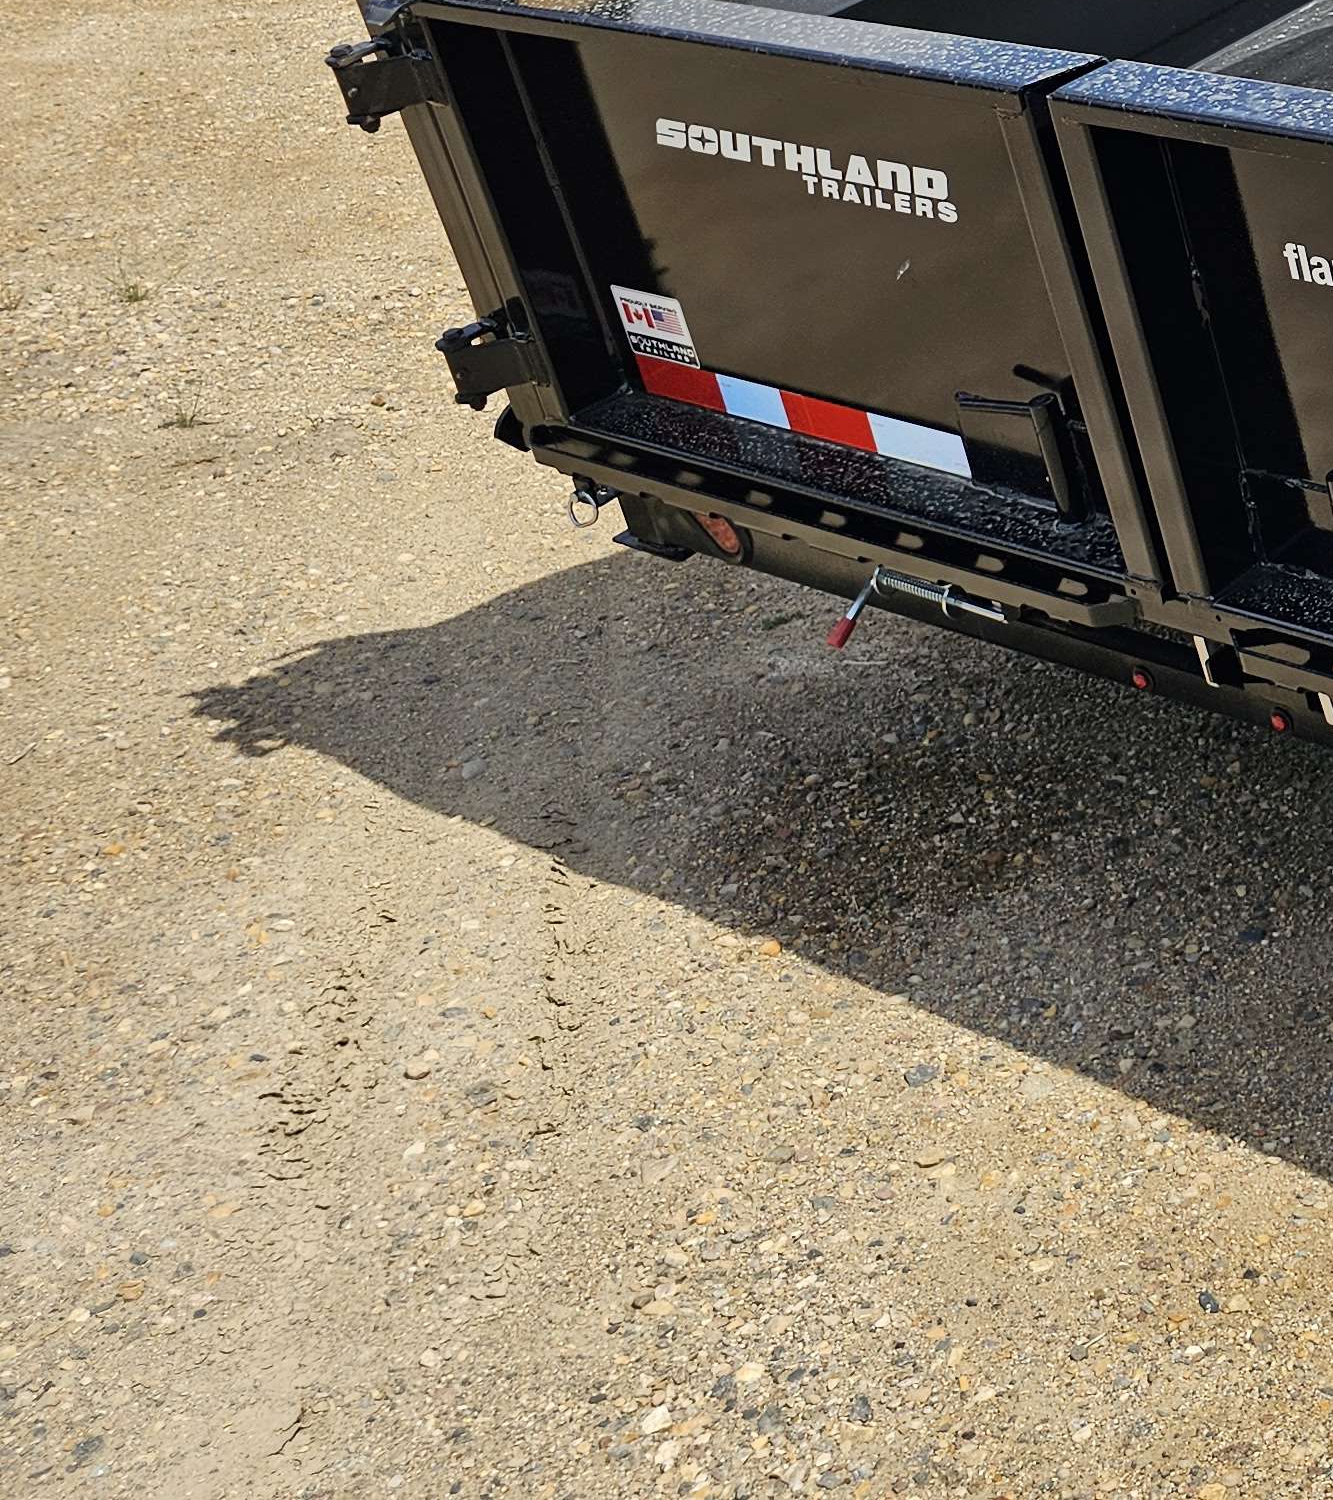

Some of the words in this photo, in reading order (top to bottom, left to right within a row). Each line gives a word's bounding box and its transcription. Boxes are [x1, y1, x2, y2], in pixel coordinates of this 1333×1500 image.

[656, 117, 949, 201] SOUTHLAND
[802, 173, 959, 224] TRAILERS
[630, 335, 695, 358] SOUTHLAND
